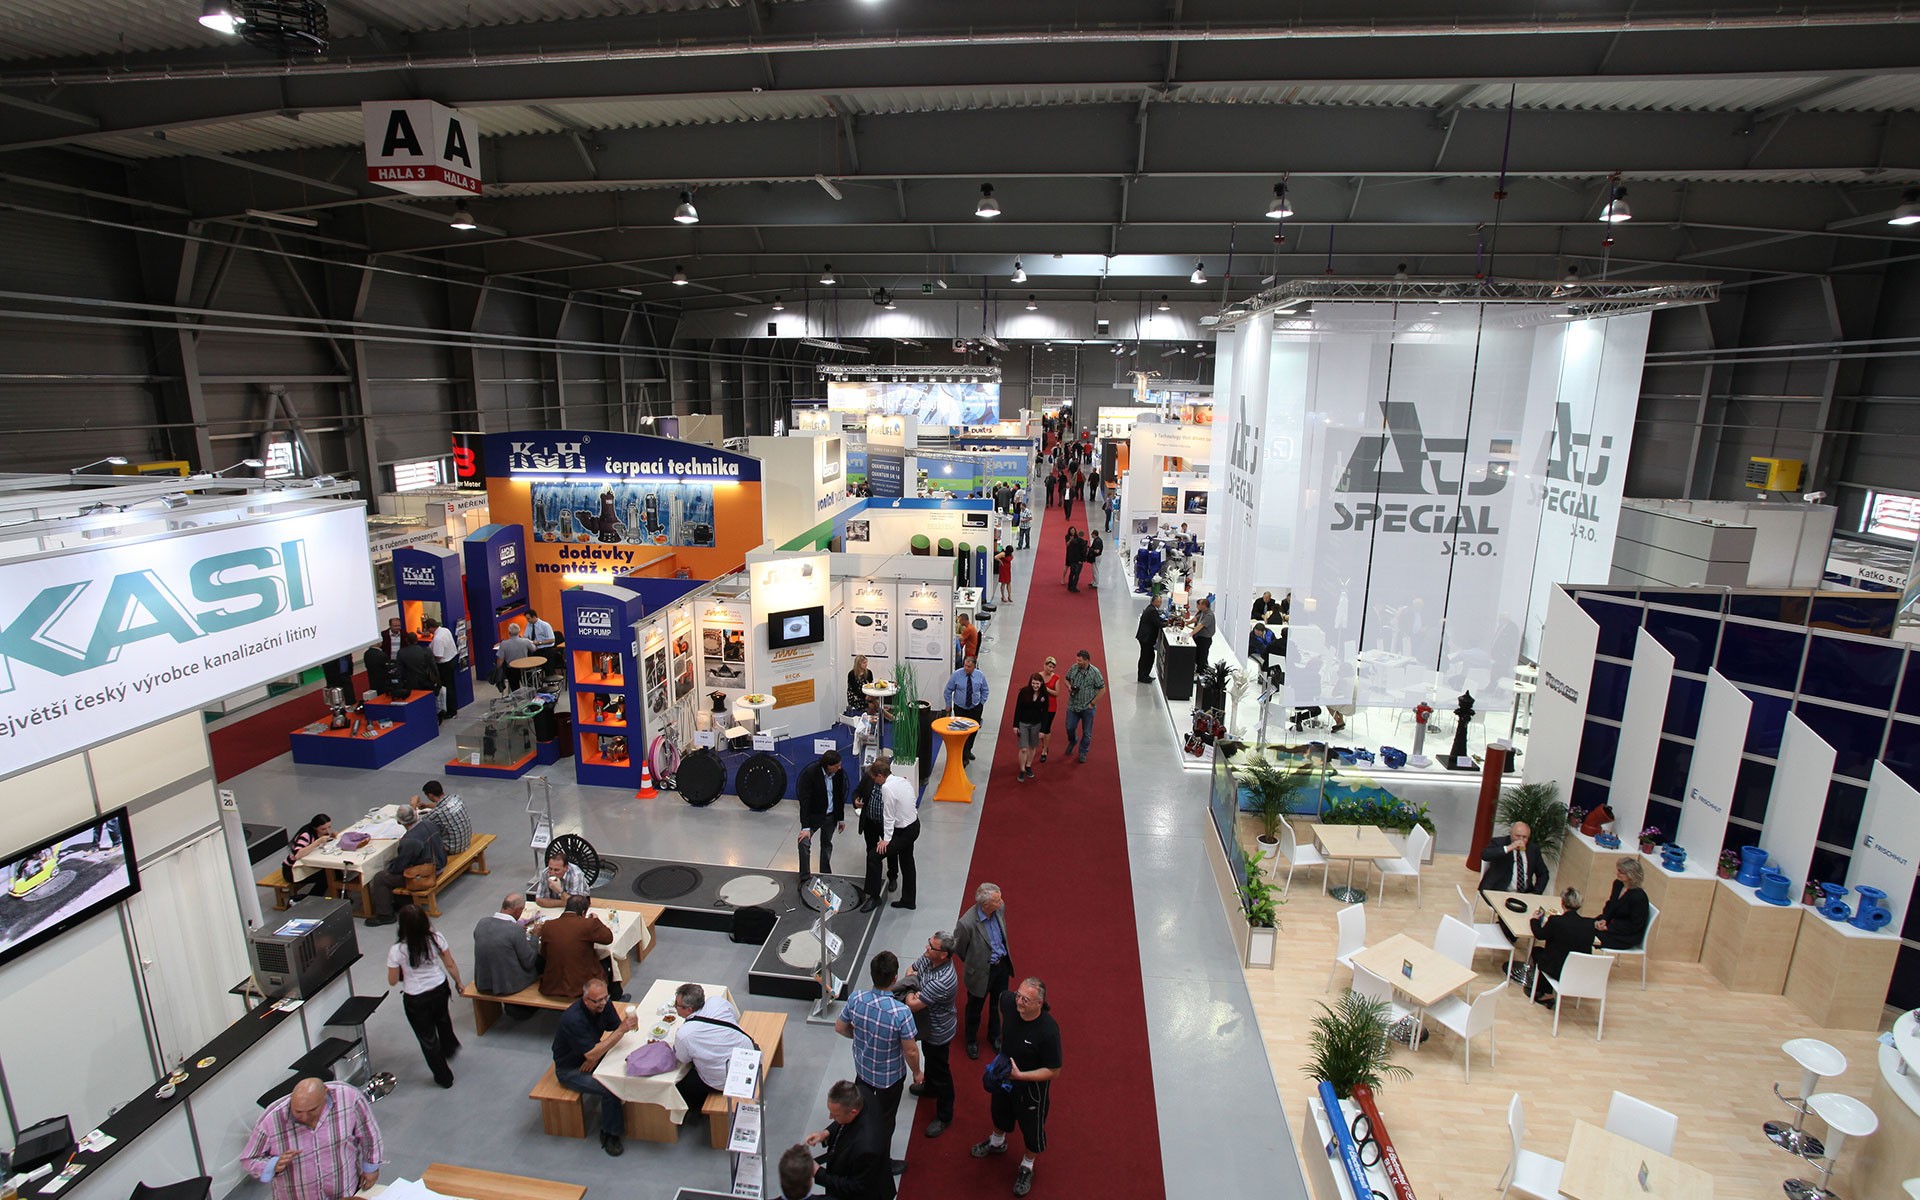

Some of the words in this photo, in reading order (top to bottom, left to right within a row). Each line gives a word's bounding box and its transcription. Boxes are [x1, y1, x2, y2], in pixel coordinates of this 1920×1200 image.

[381, 110, 424, 157] A
[444, 118, 472, 169] A
[378, 168, 413, 180] HALA
[418, 168, 426, 179] 3
[444, 170, 468, 188] HALA
[470, 179, 476, 190] 3
[605, 456, 664, 478] čerpací
[668, 457, 739, 476] technika
[410, 531, 439, 544] omezeným
[559, 545, 635, 564] dodávky
[535, 561, 598, 574] montáž
[1858, 567, 1885, 582] Katko
[578, 627, 591, 636] HCP
[593, 628, 612, 637] PUMP
[75, 681, 128, 712] český
[133, 662, 200, 694] výrobce
[204, 632, 283, 670] kanalizační
[285, 623, 318, 644] litiny
[223, 798, 234, 807] 20
